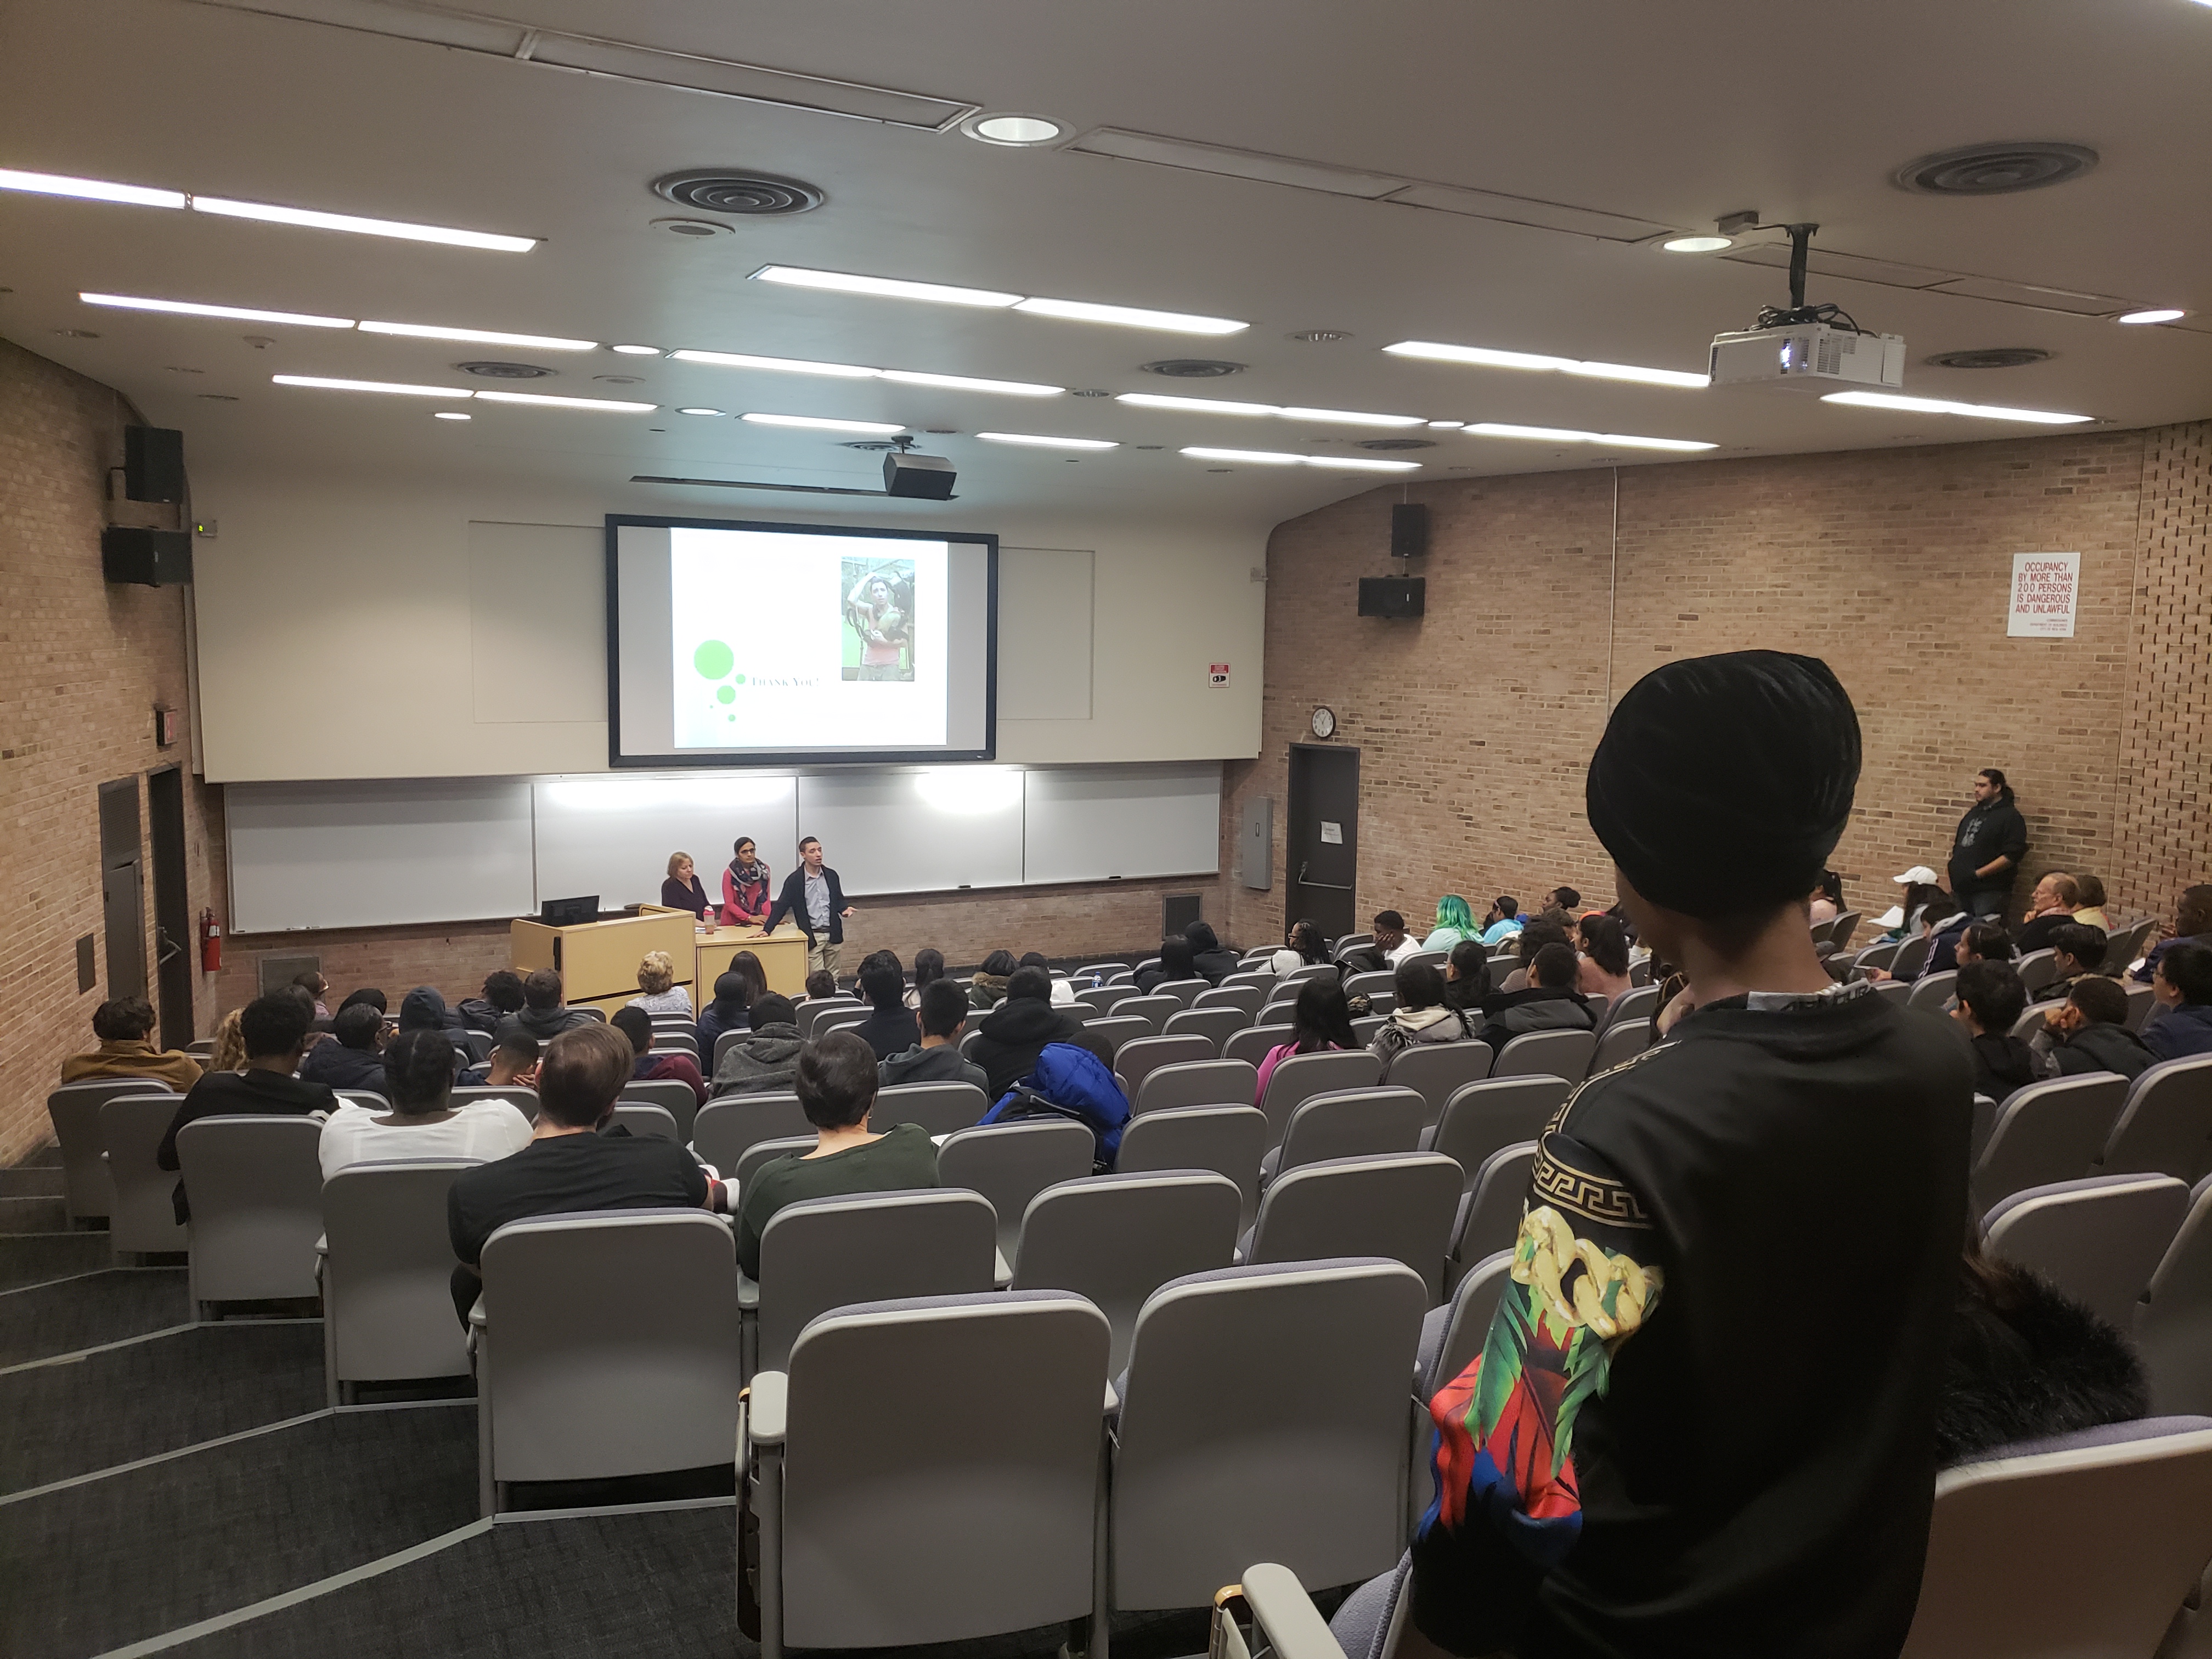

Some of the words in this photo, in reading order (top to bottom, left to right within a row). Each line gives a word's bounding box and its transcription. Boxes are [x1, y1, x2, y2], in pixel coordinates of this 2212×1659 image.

[2024, 562, 2068, 572] OCCUPANCY
[2018, 573, 2027, 582] BY
[2030, 573, 2051, 582] MORE
[2054, 573, 2073, 582] THAN
[2018, 583, 2035, 592] 200
[2038, 583, 2072, 592] PERSONS
[2017, 594, 2024, 603] IS
[2027, 594, 2070, 603] DANGEROUS
[2016, 604, 2030, 613] AND
[2033, 604, 2070, 614] UNLAWFUL
